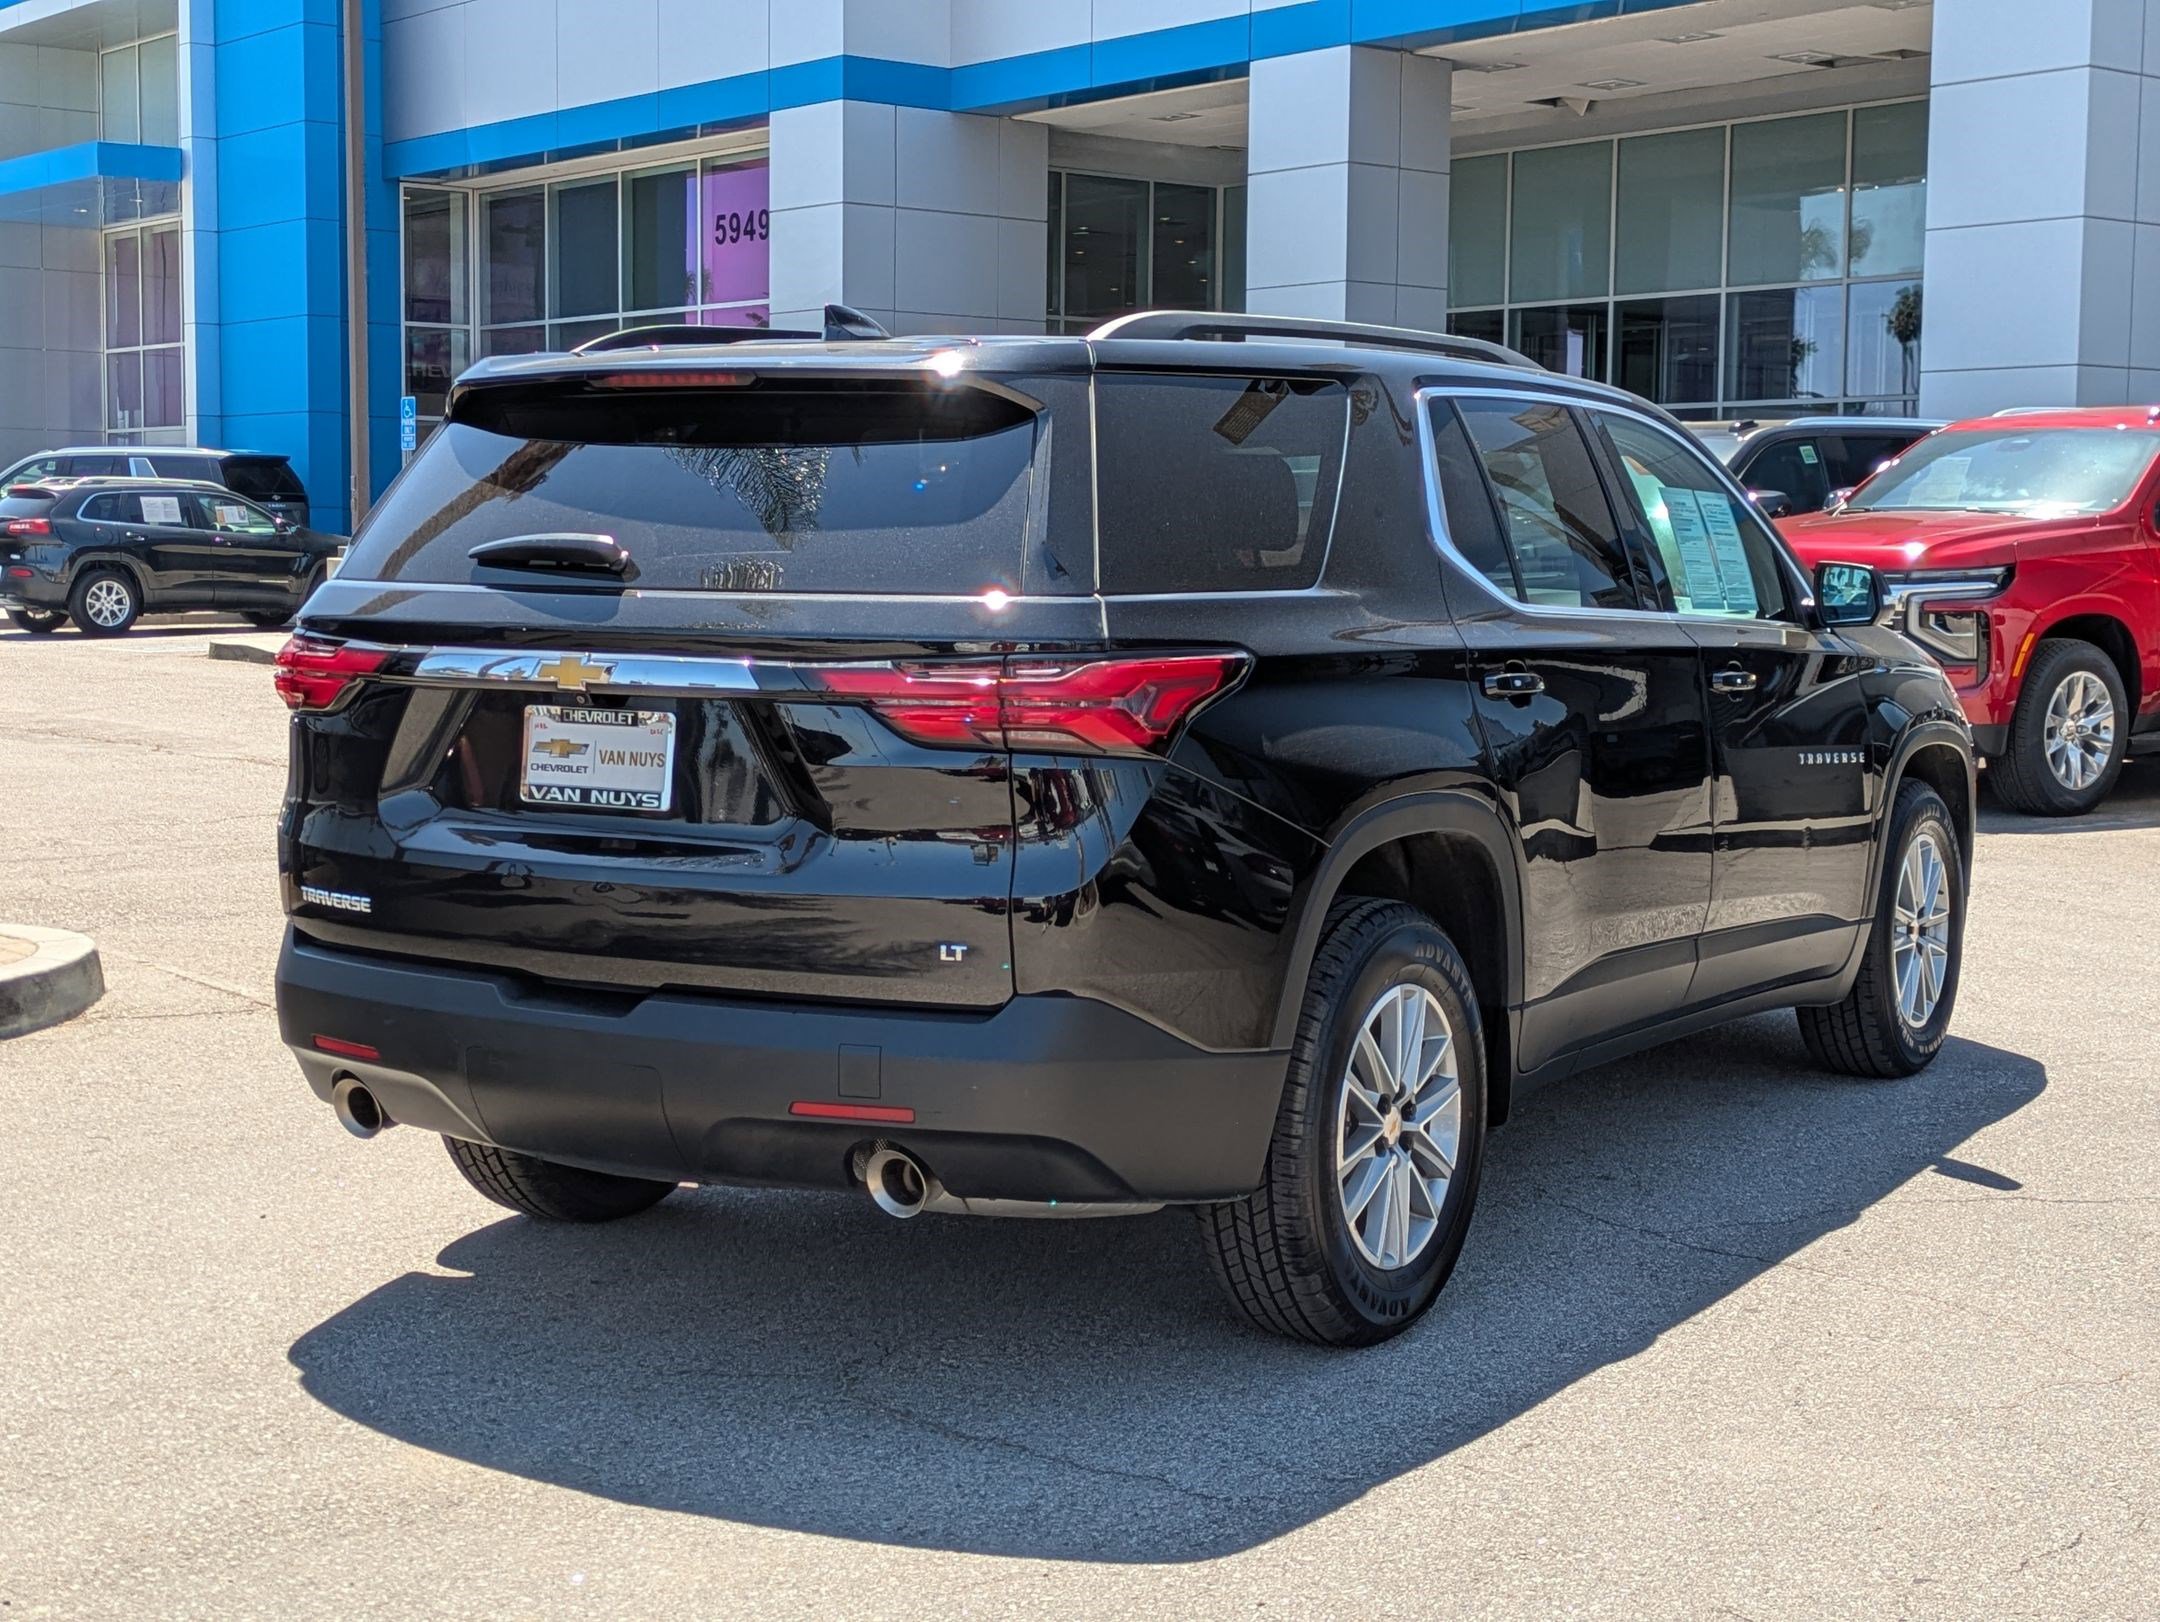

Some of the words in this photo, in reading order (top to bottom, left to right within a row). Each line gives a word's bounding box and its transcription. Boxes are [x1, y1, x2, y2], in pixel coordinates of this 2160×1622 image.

[714, 208, 770, 246] 5949
[563, 709, 635, 726] CHEVROLET
[599, 749, 626, 766] VAN
[628, 750, 666, 768] NUYS
[1798, 752, 1866, 765] TRAVERSE
[530, 763, 589, 774] CHEVROLET
[529, 785, 581, 802] VAN
[590, 790, 660, 808] NUYS
[300, 885, 372, 913] TRAVERSE
[940, 944, 968, 962] LT
